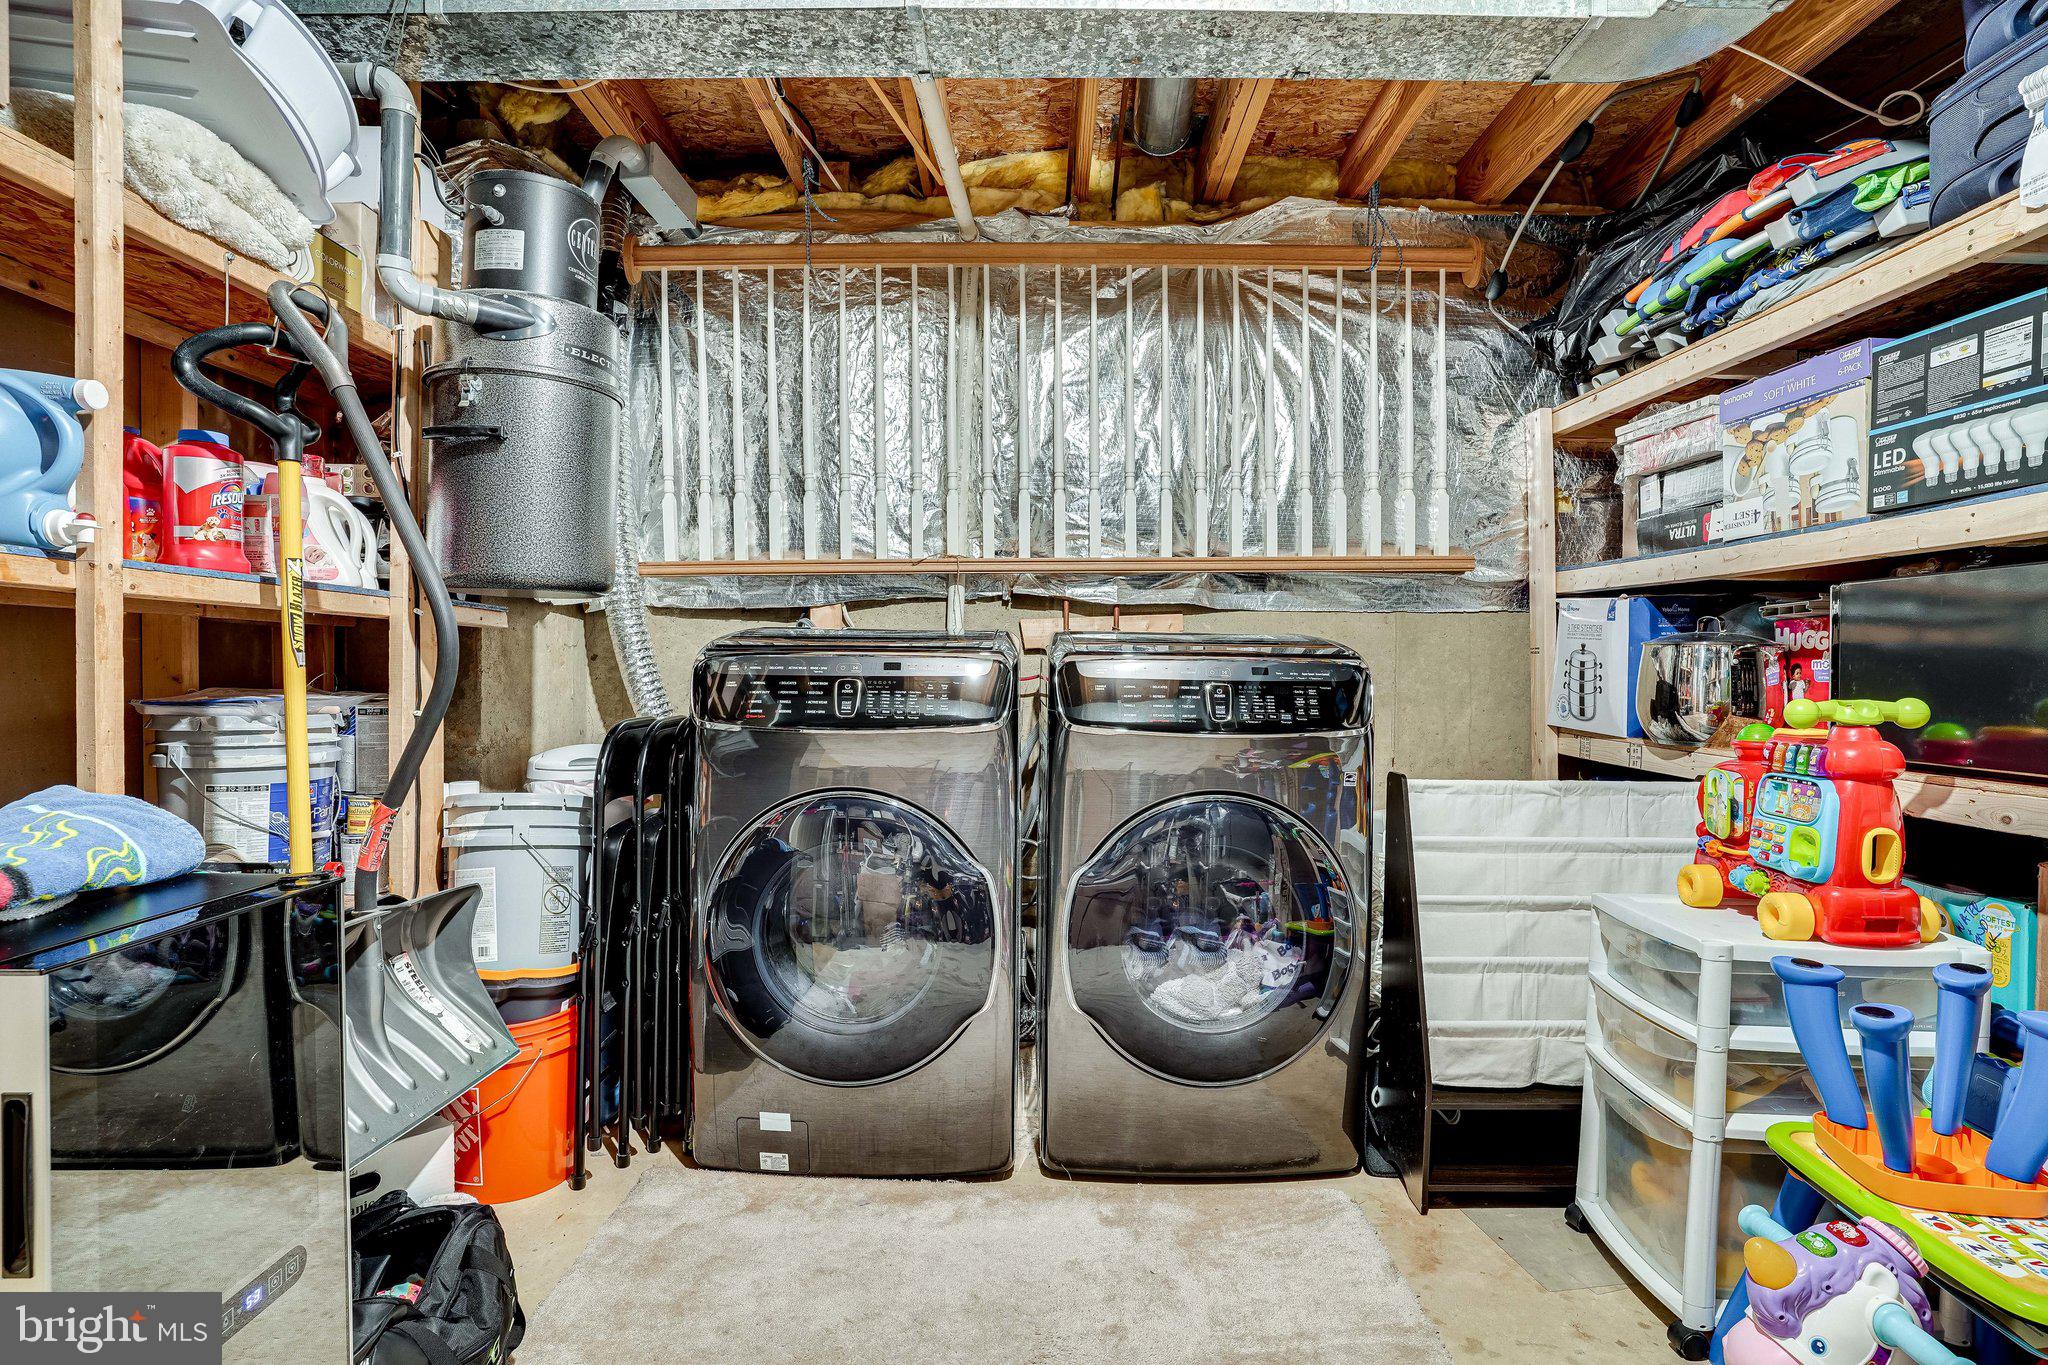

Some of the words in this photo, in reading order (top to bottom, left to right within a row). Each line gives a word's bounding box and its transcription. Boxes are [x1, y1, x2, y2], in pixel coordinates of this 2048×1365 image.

[1763, 386, 1785, 402] SOFT
[1786, 374, 1817, 393] WHITE
[1873, 447, 1907, 470] LED
[1873, 465, 1906, 477] Dimmable
[1873, 485, 1892, 494] FLOOD
[1669, 525, 1697, 541] ULTRA
[1981, 914, 2015, 929] SOFTEST
